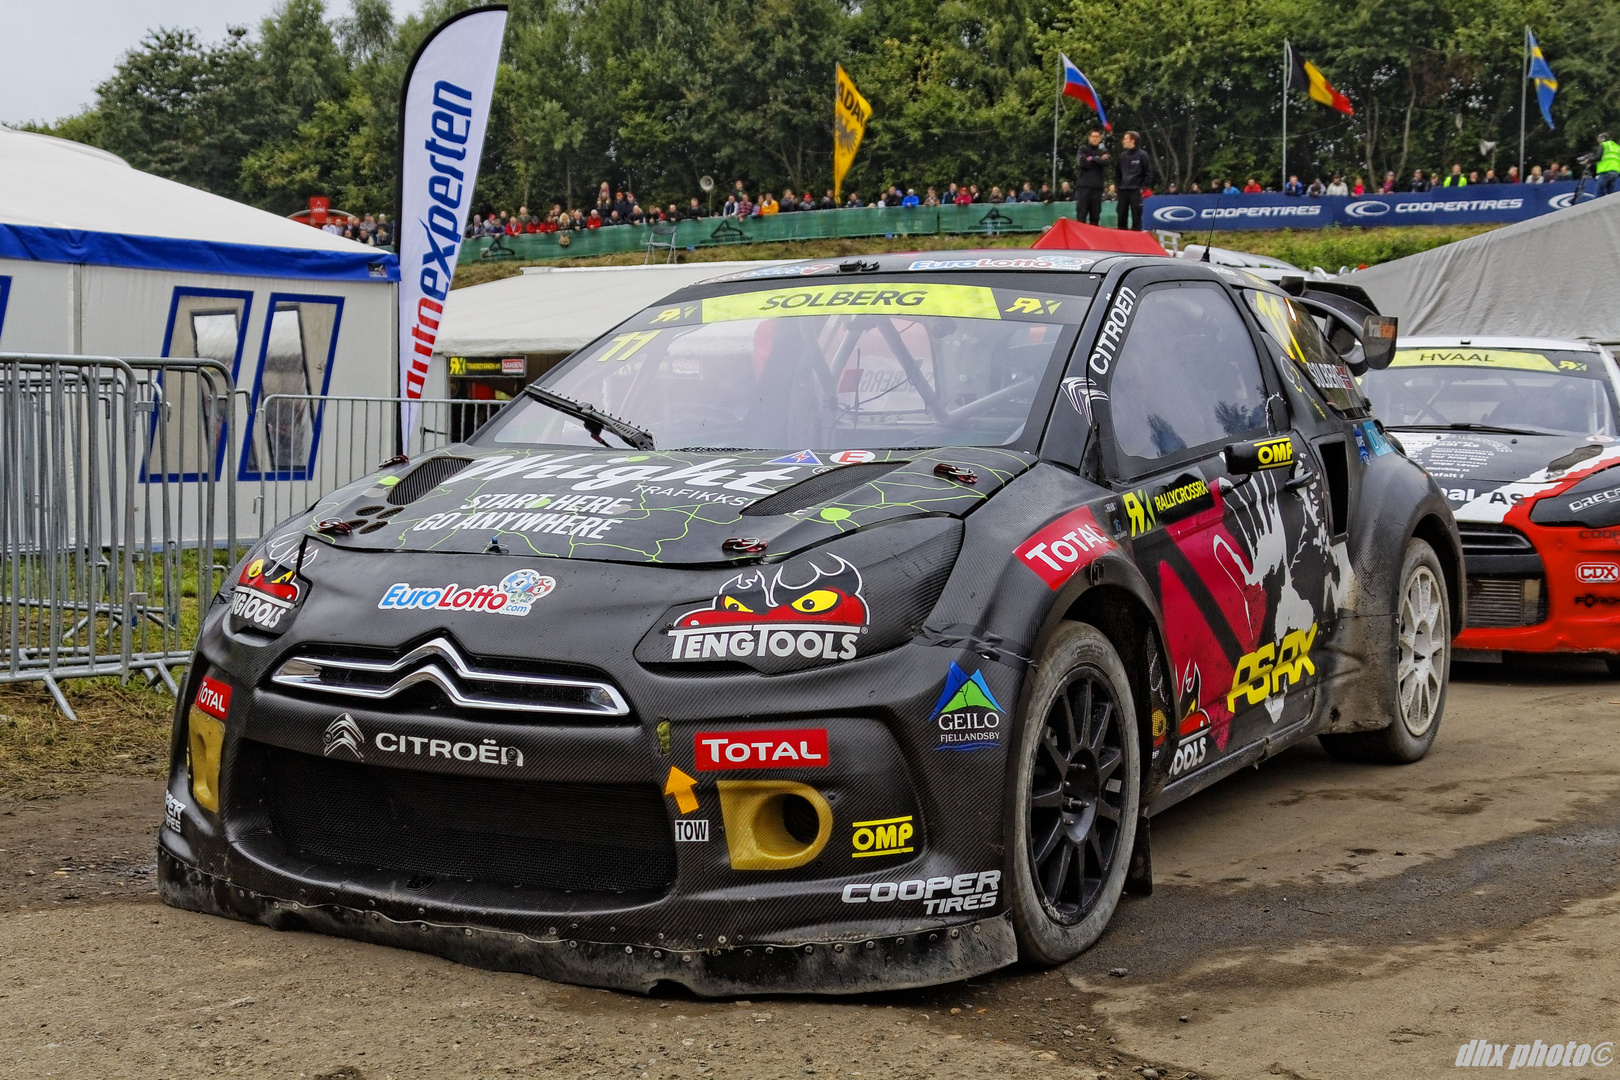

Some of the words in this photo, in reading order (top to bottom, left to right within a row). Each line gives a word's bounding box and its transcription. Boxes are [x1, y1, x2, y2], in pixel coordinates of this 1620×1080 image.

[759, 290, 927, 311] SOLBERG
[597, 330, 662, 361] 11
[1420, 353, 1495, 362] HVAAL
[1258, 442, 1293, 464] OMP
[441, 453, 802, 495] Wright
[460, 493, 556, 510] START
[544, 494, 633, 515] HERE
[1154, 480, 1209, 512] RALLYCROSSRX
[413, 512, 461, 532] GO
[456, 512, 623, 540] ANYWHERE
[1025, 524, 1109, 571] TOTAL
[1581, 566, 1616, 579] CDX
[668, 624, 860, 660] TENGTOOLS
[199, 681, 226, 712] TOTAL
[938, 712, 999, 731] GEILO
[940, 732, 1000, 743] FJELLANDSBY
[702, 739, 822, 763] TOTAL
[676, 821, 707, 841] TOW
[852, 823, 914, 850] OMP
[841, 870, 1001, 903] COOPER
[923, 891, 998, 915] TIRES
